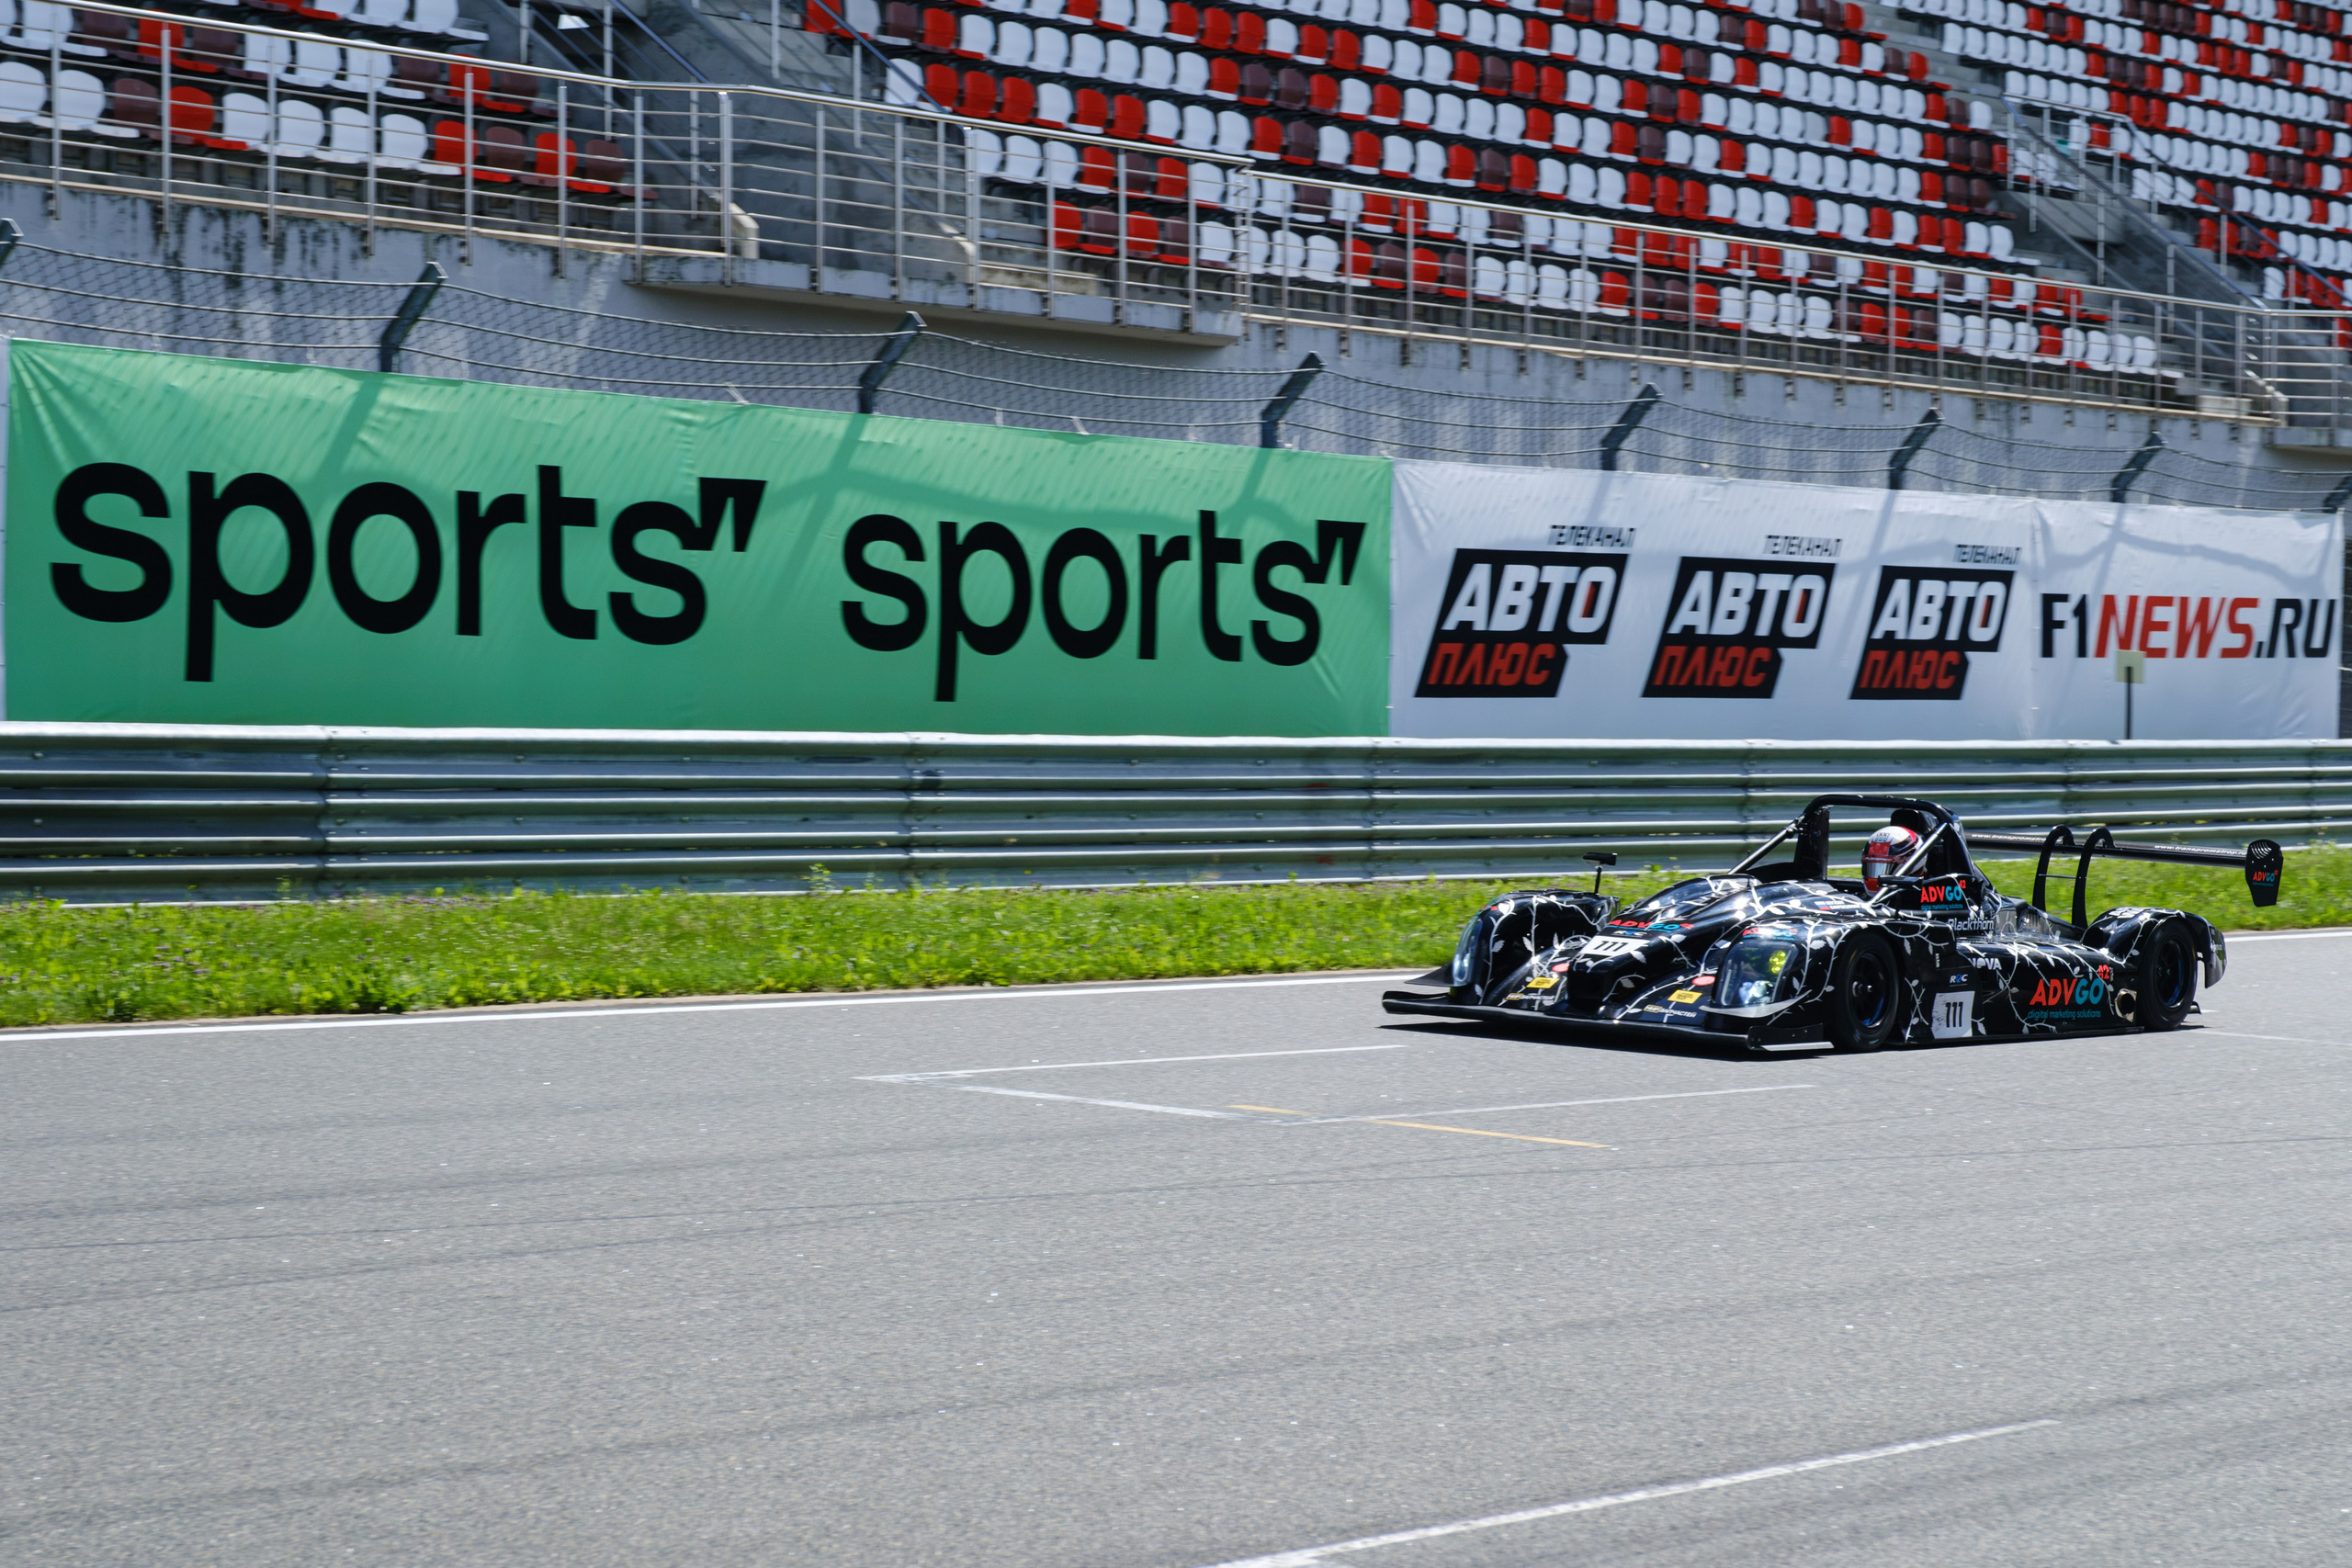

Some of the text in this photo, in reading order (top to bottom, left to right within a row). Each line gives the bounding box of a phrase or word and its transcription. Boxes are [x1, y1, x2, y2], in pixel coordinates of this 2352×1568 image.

[1440, 563, 1618, 633] АВТО
[1667, 570, 1826, 638] АВТО
[1870, 579, 2007, 642] АВТО
[2040, 593, 2337, 659] F1NEWS.RU
[1425, 643, 1557, 686] ПЛЮС
[1652, 646, 1772, 687] ПЛЮС
[1859, 650, 1961, 690] ПЛЮС
[2253, 871, 2275, 882] ADVGO
[1920, 886, 1963, 903] ADVGO
[1606, 919, 1679, 930] ADVGO
[1947, 917, 1995, 931] Blackthorn
[1593, 941, 1629, 952] 111
[2029, 977, 2104, 1006] ADVGO
[1945, 1001, 1964, 1028] 111
[2028, 1009, 2101, 1021] digital marketing solutions
